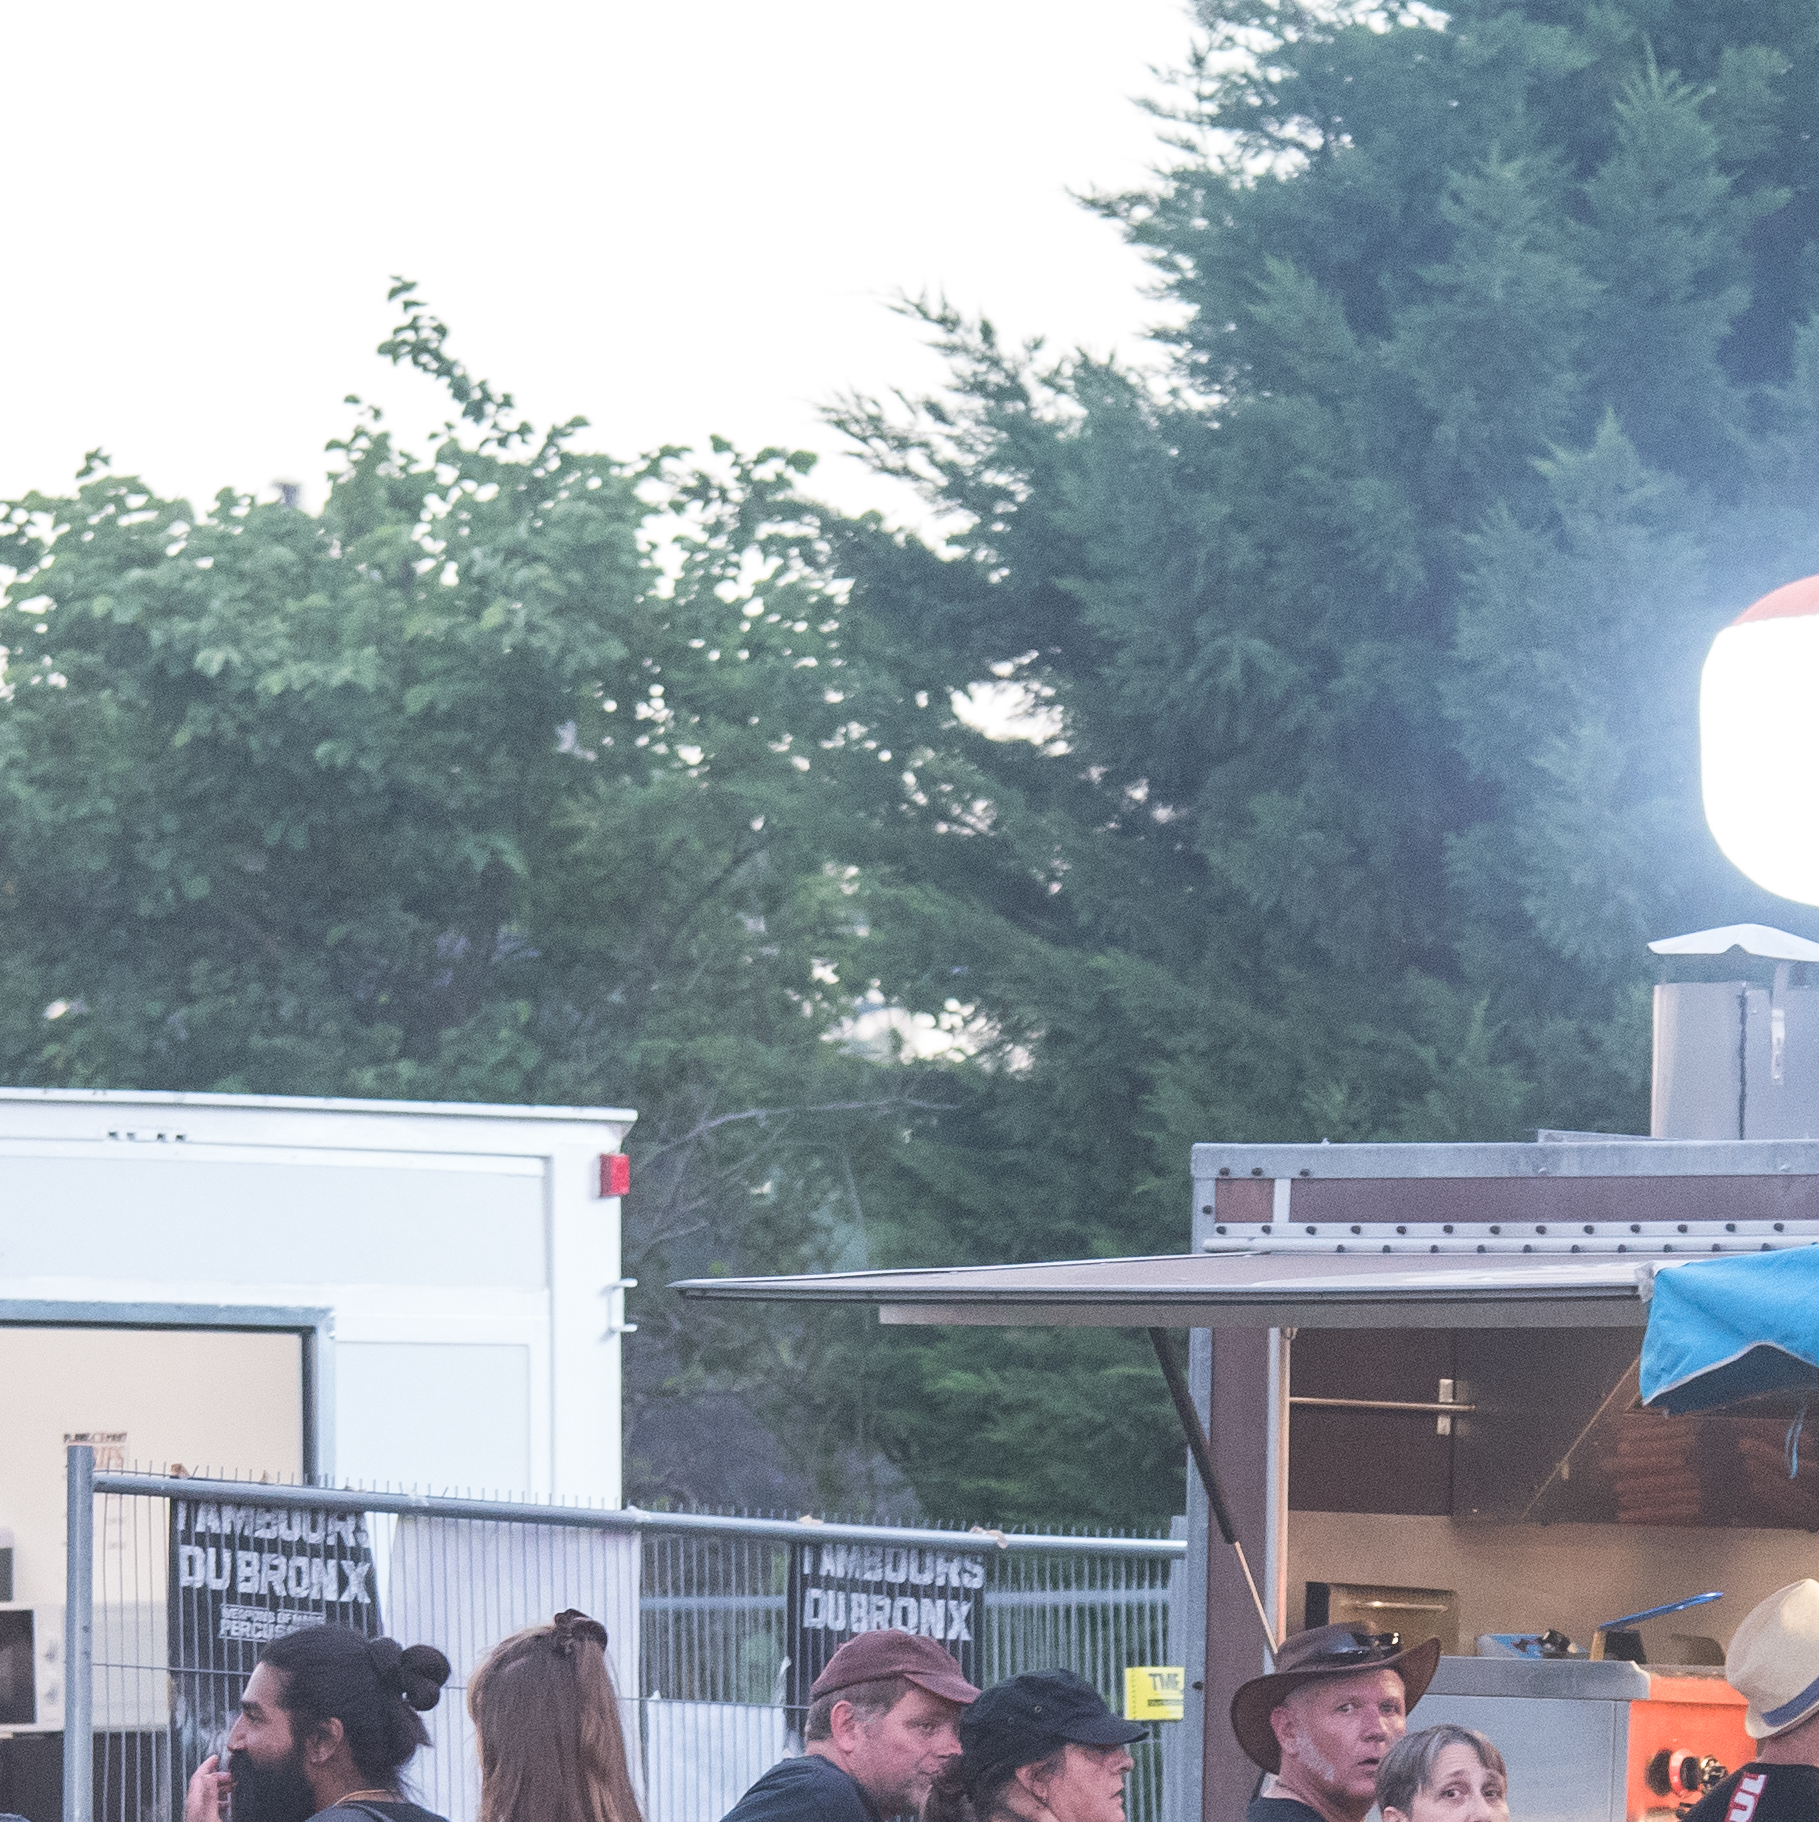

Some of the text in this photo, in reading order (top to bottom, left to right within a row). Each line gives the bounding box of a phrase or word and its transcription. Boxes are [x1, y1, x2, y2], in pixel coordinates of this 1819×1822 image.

[179, 1545, 371, 1603] DU BRONX
[803, 1588, 974, 1641] DU BRONX
